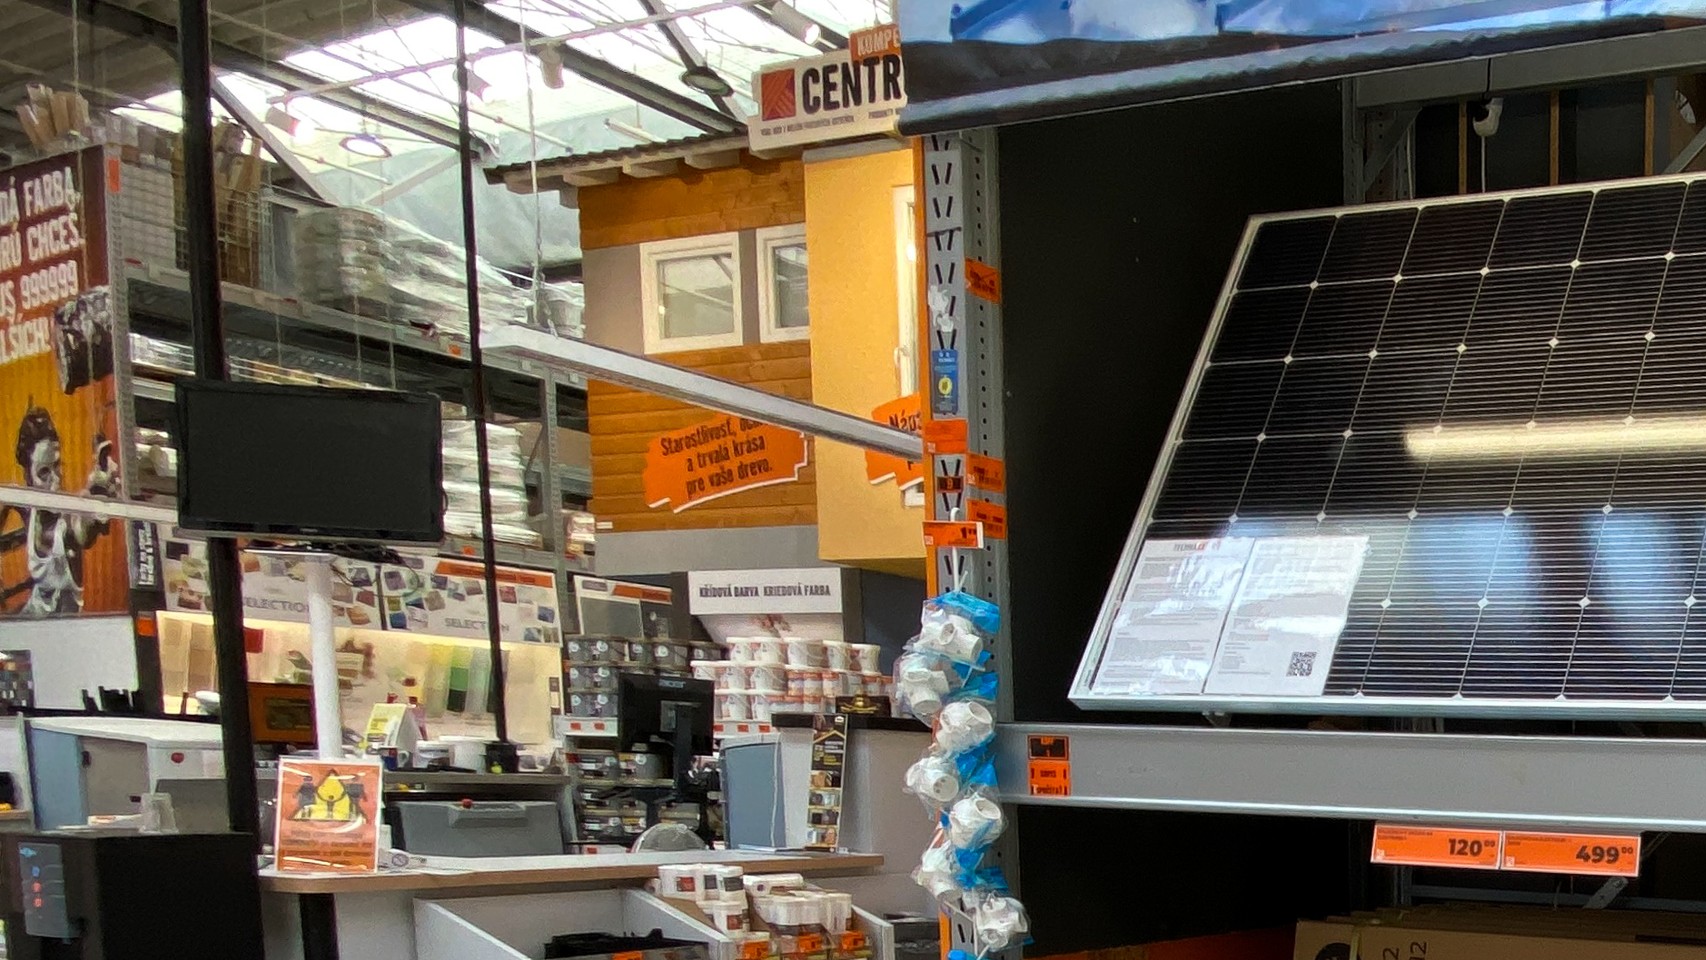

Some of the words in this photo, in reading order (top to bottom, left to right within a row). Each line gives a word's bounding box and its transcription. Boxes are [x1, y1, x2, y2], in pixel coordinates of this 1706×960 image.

[802, 54, 902, 115] CENTR
[687, 457, 693, 472] a
[732, 435, 765, 457] krása
[686, 478, 705, 499] pre
[708, 465, 733, 487] vaše
[804, 585, 831, 596] FARBA
[1449, 838, 1482, 856] 120
[1575, 844, 1619, 864] 499
